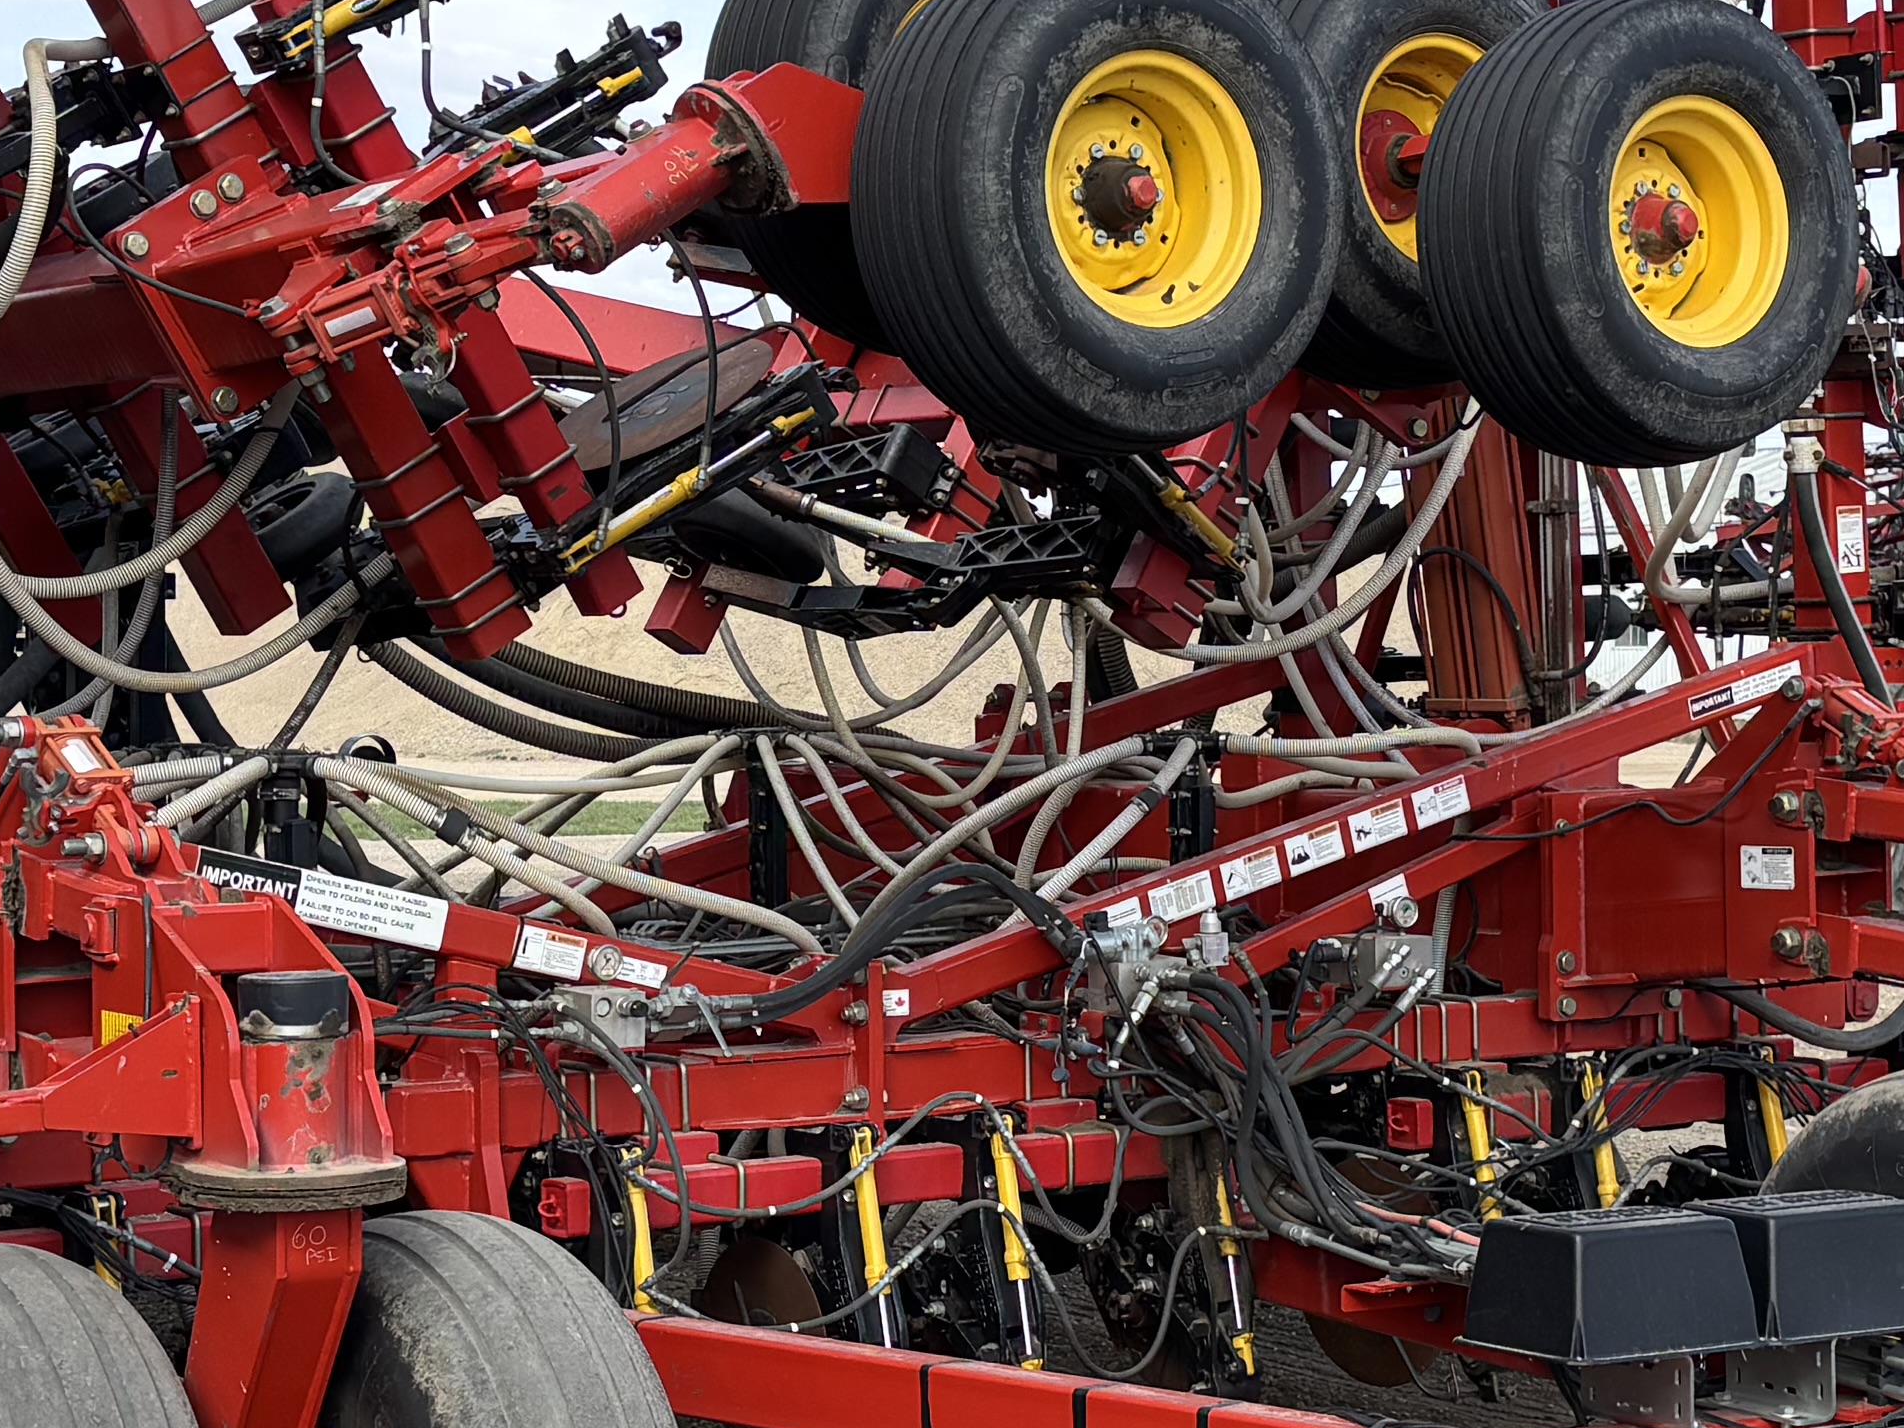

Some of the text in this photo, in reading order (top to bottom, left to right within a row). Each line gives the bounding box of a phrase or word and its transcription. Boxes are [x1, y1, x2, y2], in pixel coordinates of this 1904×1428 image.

[202, 864, 298, 900] IMPORTANT
[291, 1222, 327, 1250] 60
[306, 1246, 340, 1266] PSI
